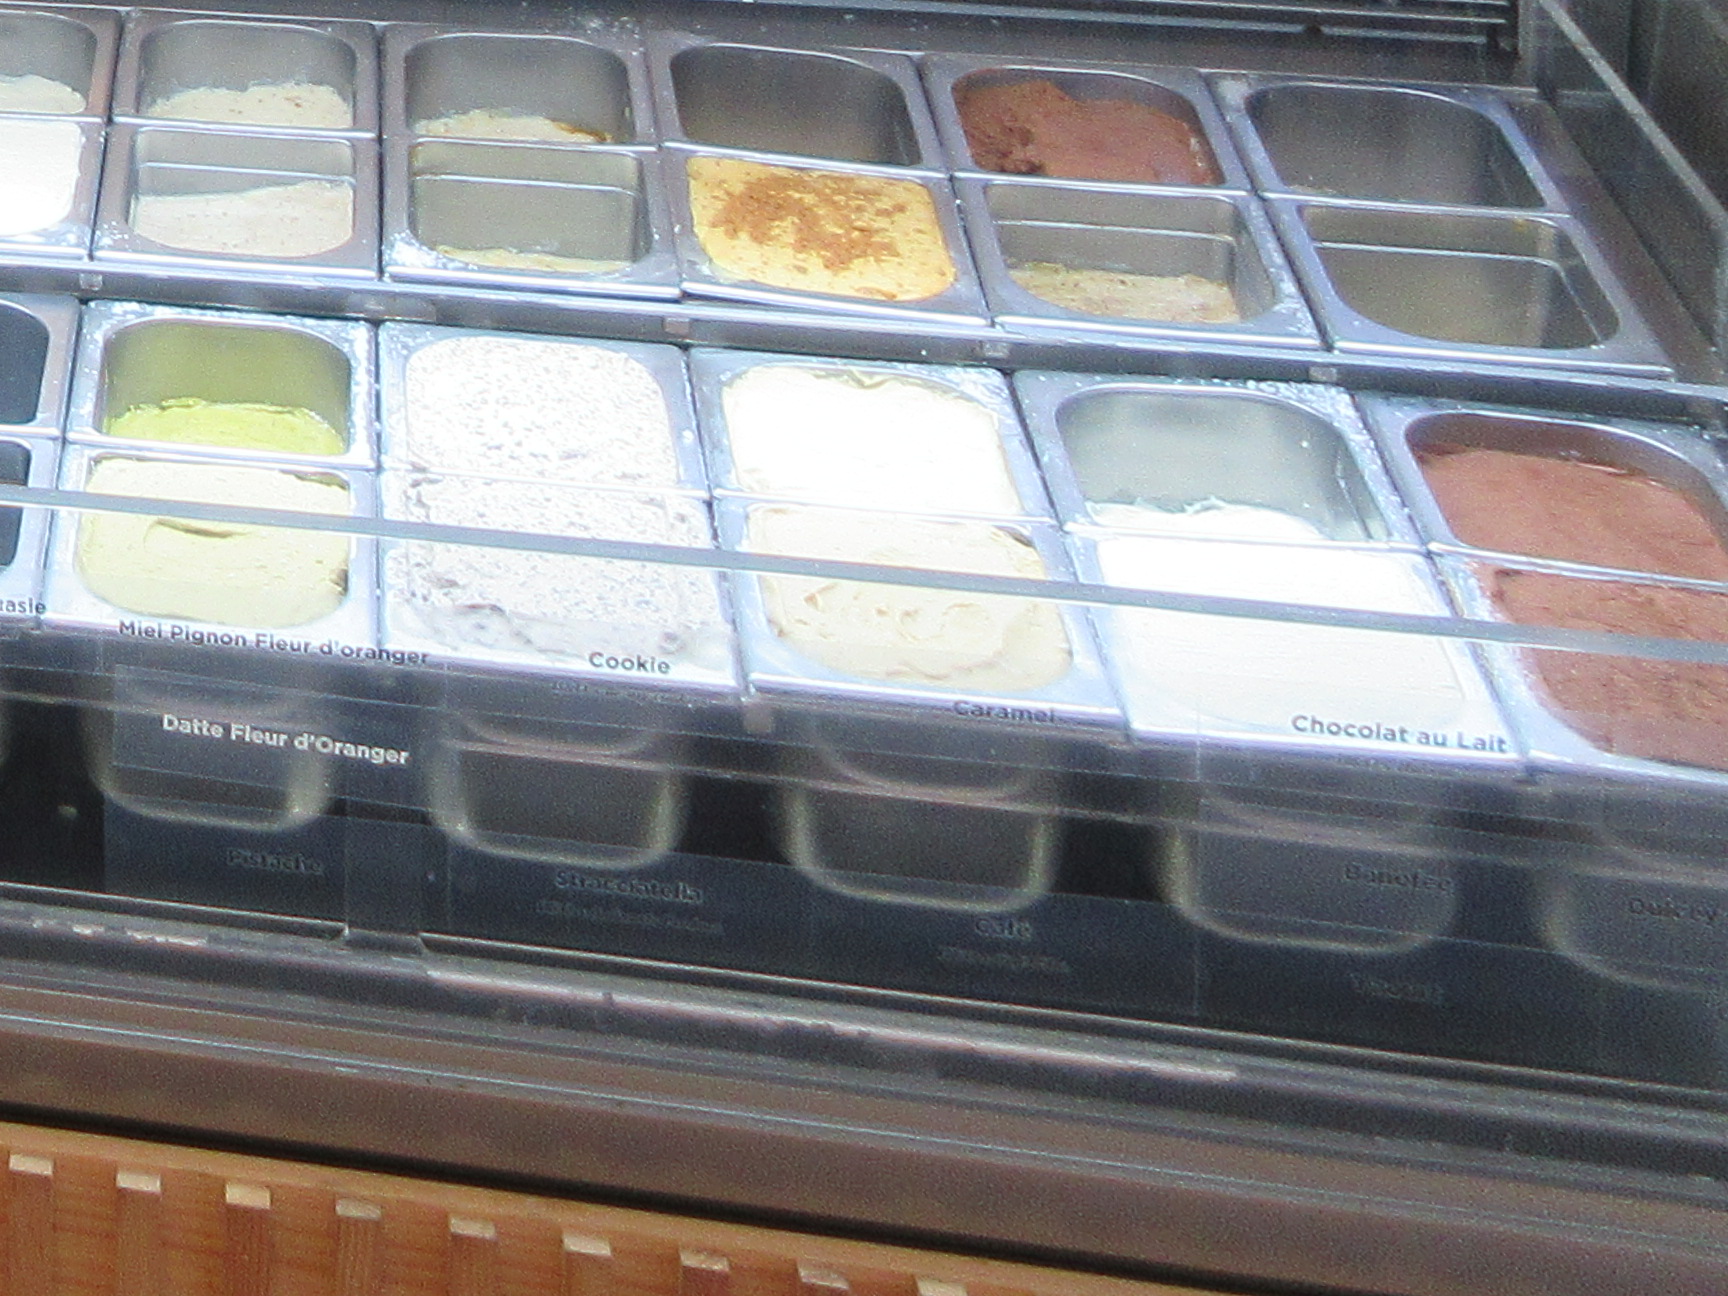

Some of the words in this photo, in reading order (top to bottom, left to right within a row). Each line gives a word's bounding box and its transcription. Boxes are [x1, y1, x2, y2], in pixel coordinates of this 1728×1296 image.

[118, 619, 164, 642] Miel
[169, 623, 247, 653] Pignon
[254, 631, 315, 656] Fleur
[319, 637, 430, 669] d'oranger
[588, 650, 671, 676] Cookie
[952, 698, 1056, 725] Caramel
[162, 712, 225, 740] Datte
[229, 720, 289, 748] Fleur
[293, 729, 410, 768] d'Oranger
[1291, 713, 1409, 745] Chocolat
[1415, 725, 1447, 749] au
[1455, 729, 1508, 754] Lait
